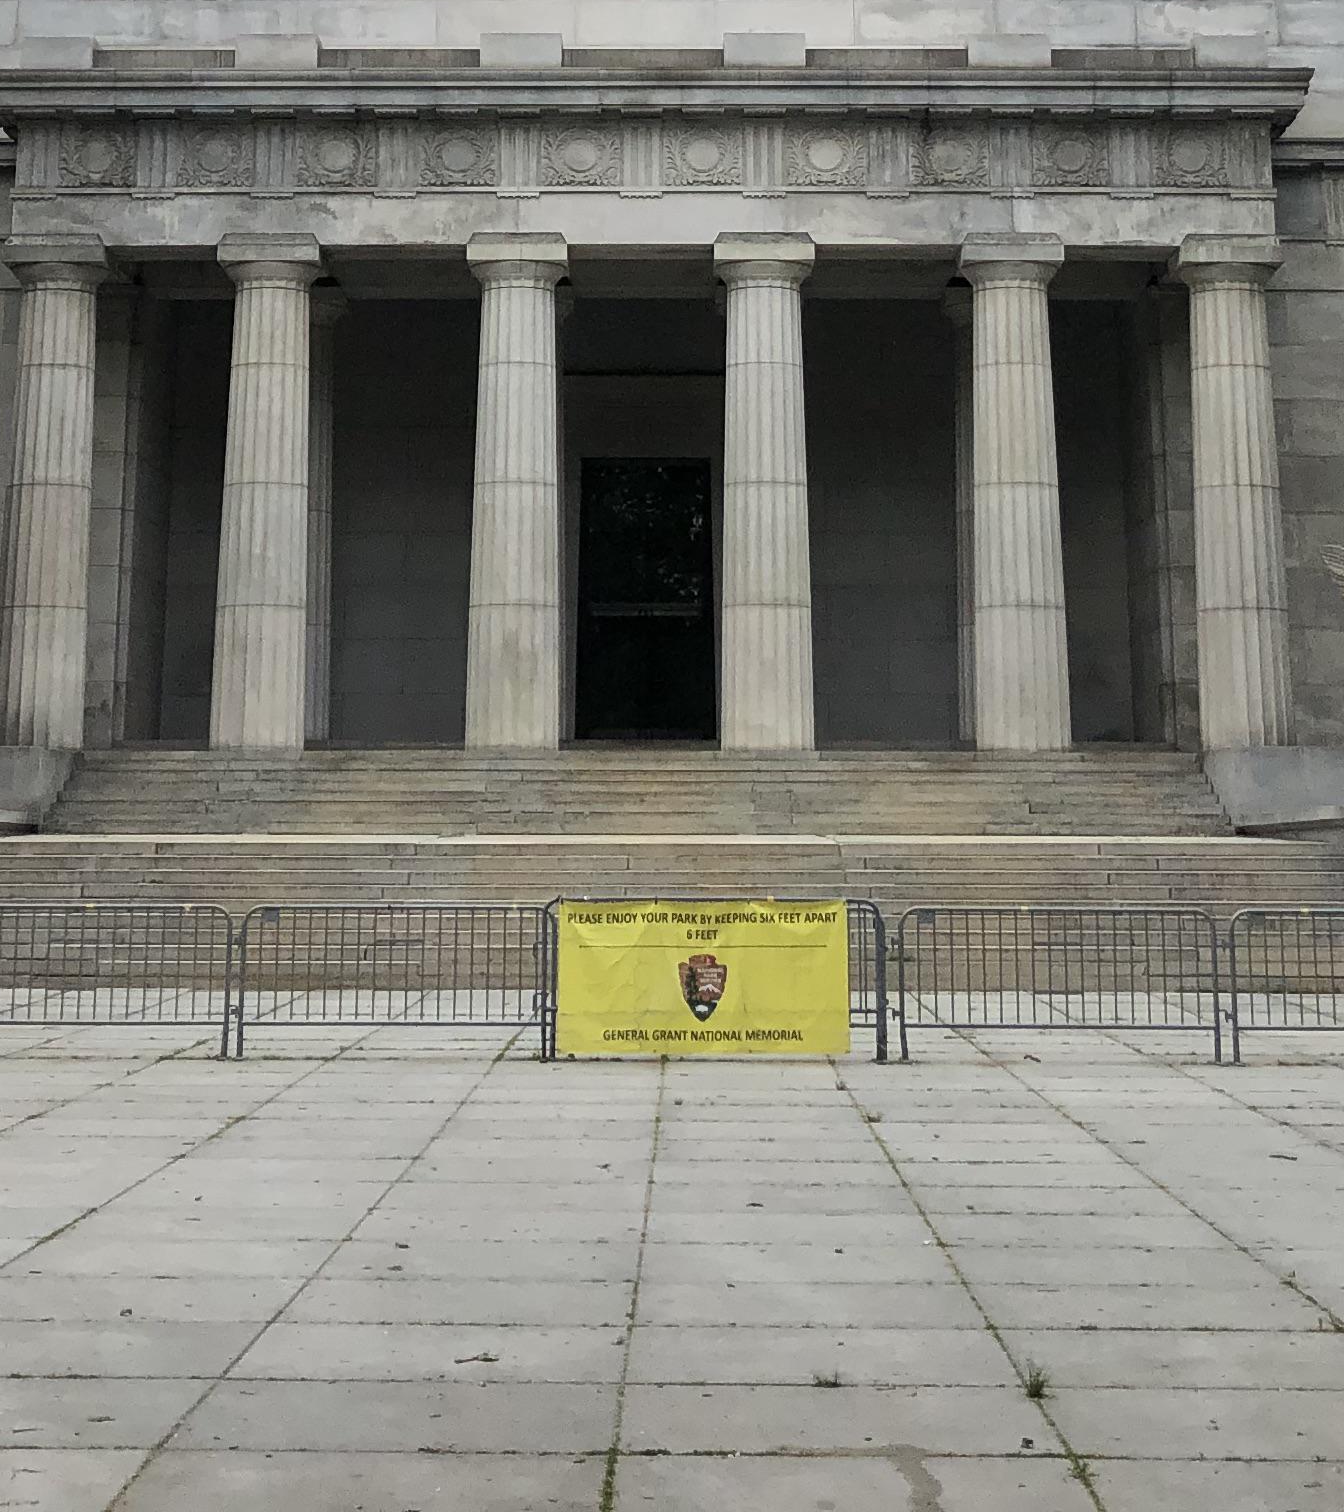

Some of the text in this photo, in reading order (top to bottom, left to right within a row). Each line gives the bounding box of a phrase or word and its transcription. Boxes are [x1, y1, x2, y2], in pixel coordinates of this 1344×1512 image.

[567, 912, 838, 925] PLEASE ENJOY YOUR PARK BY KEEPING SIX FEET APART
[686, 929, 719, 940] 6 FEET
[602, 1029, 803, 1042] GENERAL GRANT NATIONAL MEMORIAL
